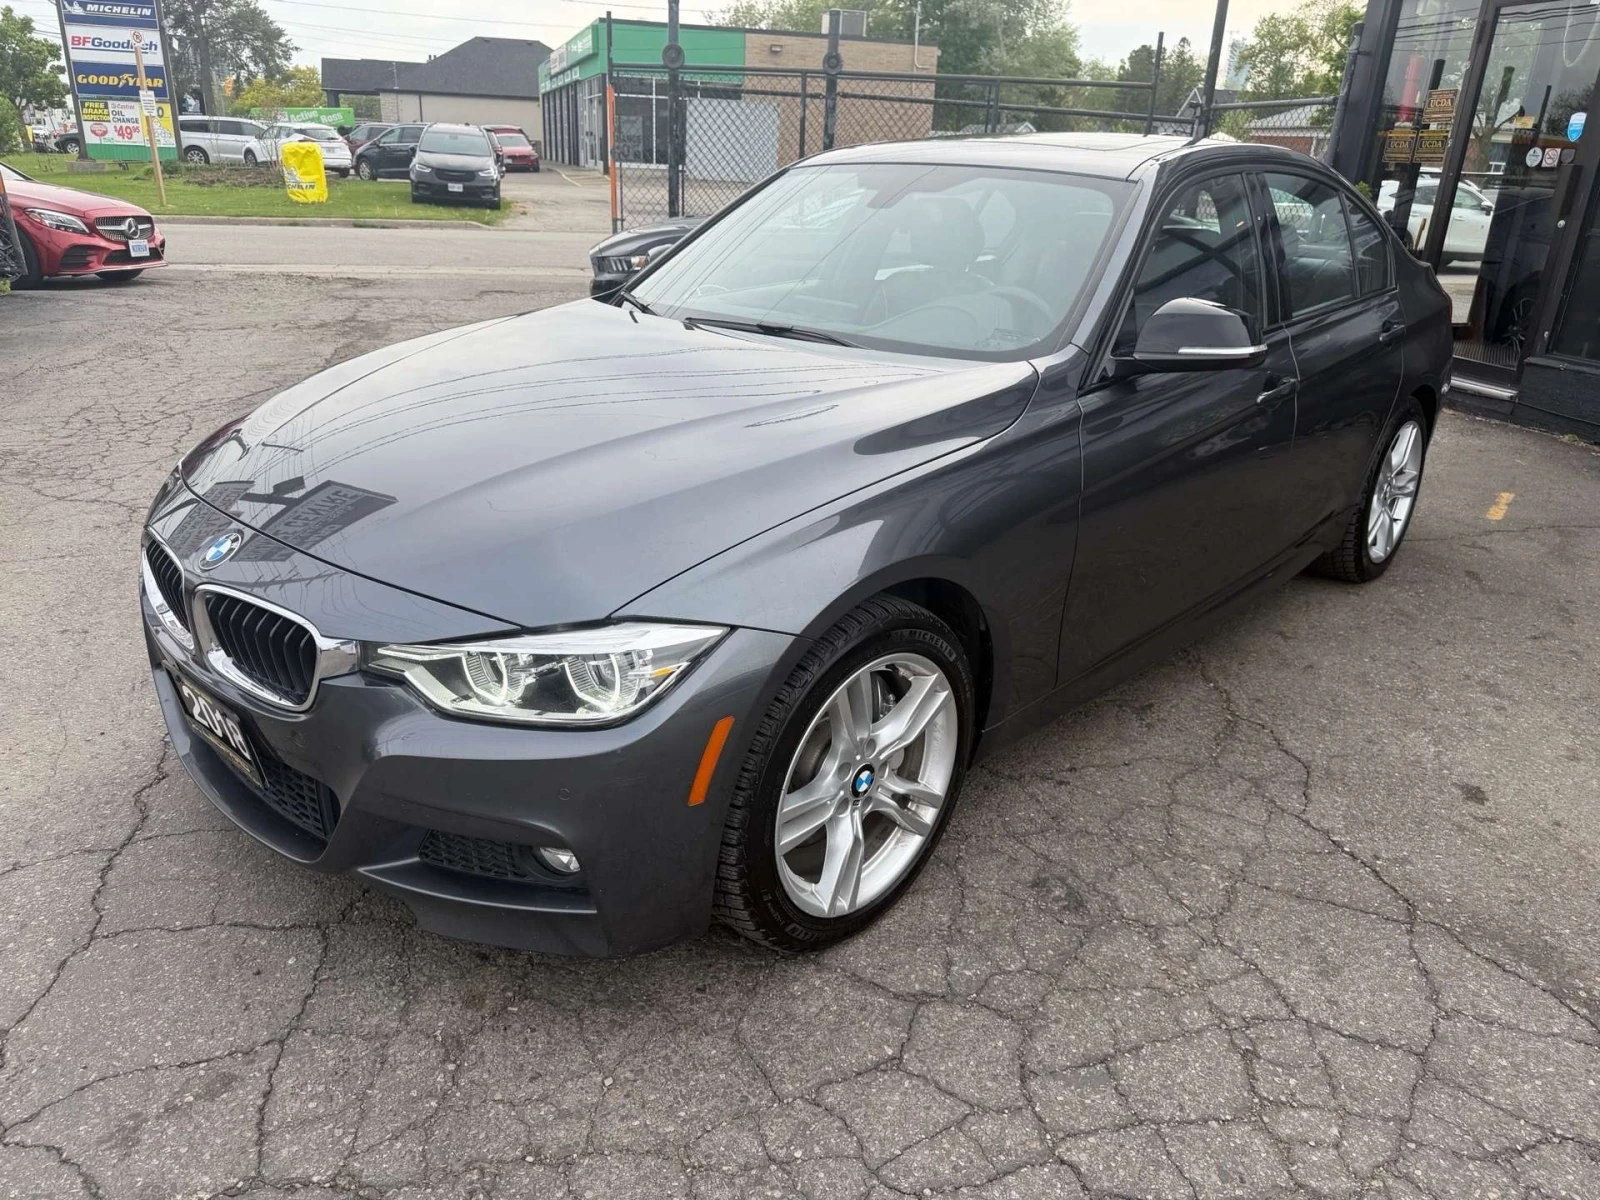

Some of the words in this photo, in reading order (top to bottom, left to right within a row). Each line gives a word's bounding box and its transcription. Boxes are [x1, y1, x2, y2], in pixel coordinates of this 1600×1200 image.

[87, 4, 152, 16] MICHELIN
[71, 35, 157, 51] BFGoodrch
[1430, 99, 1452, 108] UCDA
[83, 107, 109, 116] BRAKE
[111, 109, 126, 117] OIL
[289, 110, 319, 121] Active
[1390, 140, 1409, 149] UCDA
[1421, 140, 1442, 148] UCDA
[907, 629, 955, 659] MICHELIN
[182, 684, 252, 761] 2018
